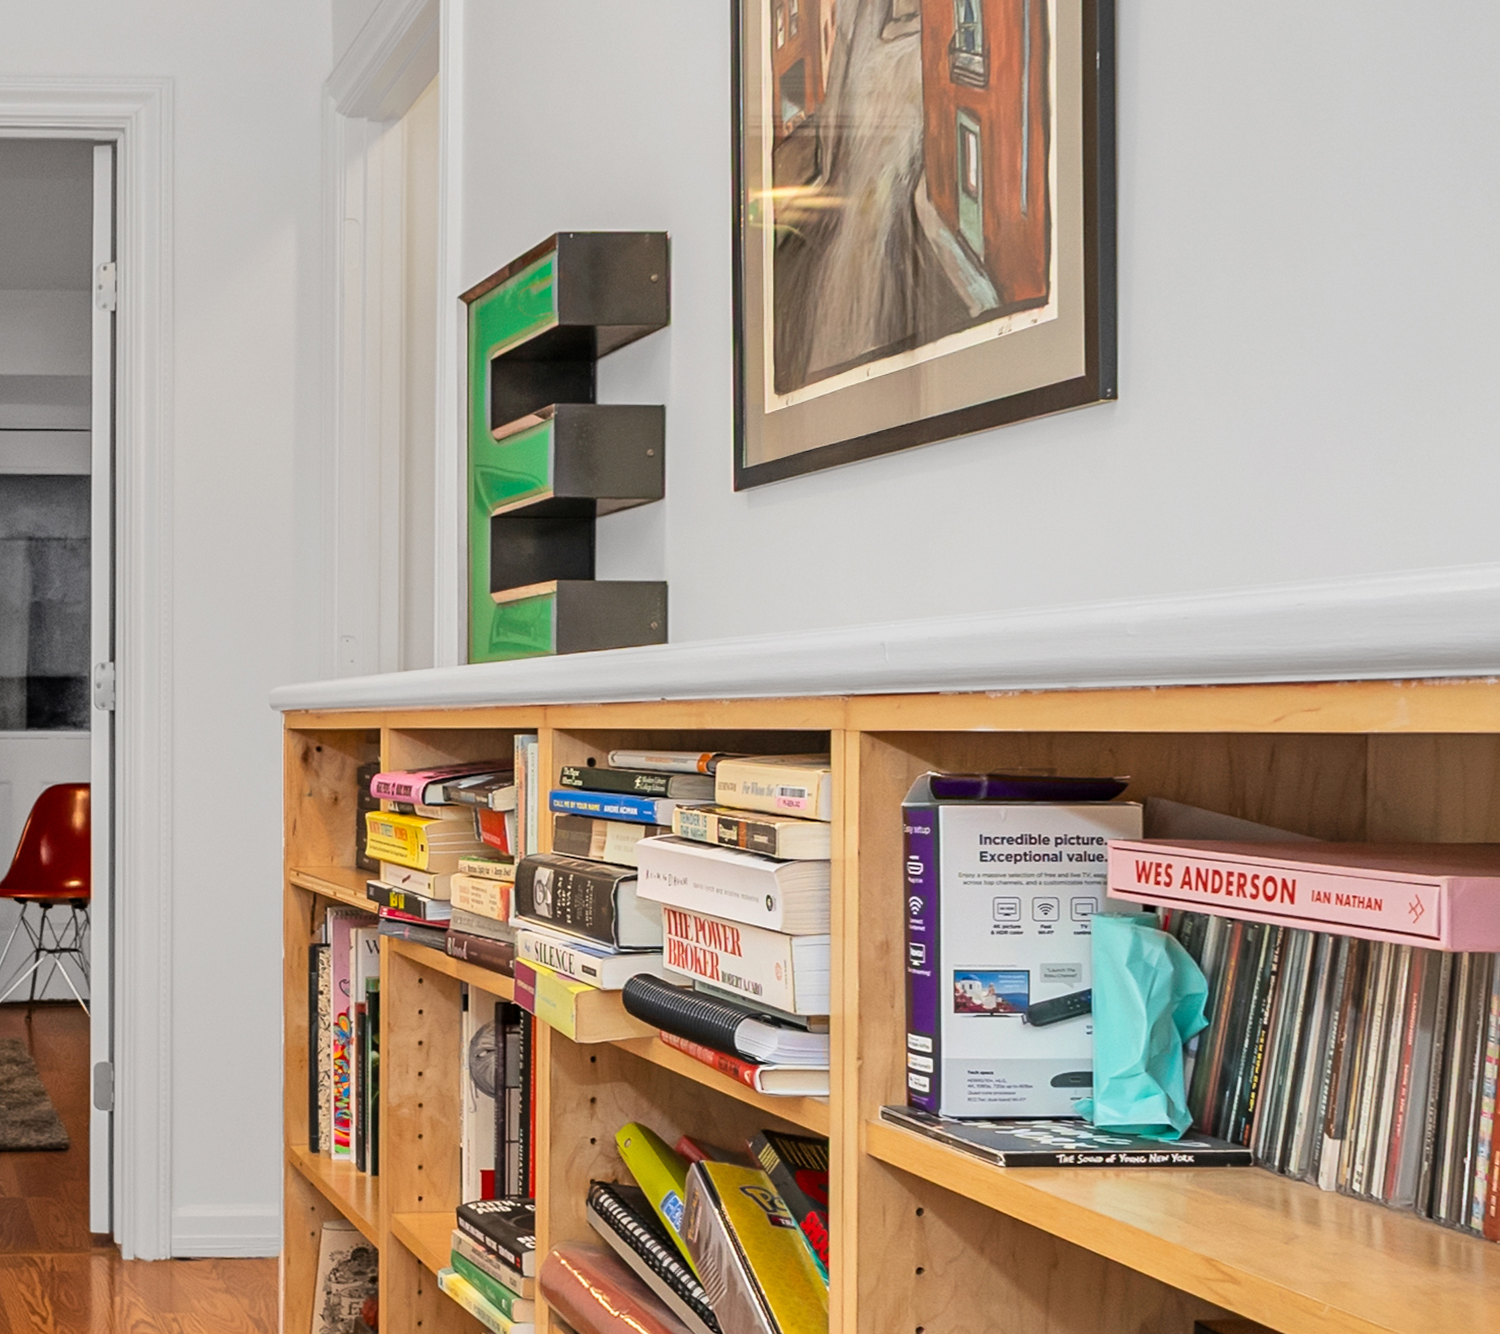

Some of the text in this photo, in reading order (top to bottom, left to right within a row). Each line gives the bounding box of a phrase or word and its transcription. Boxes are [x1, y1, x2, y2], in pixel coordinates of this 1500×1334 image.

[553, 799, 564, 807] CALL
[979, 834, 1108, 847] Incredible picture.
[979, 851, 1108, 864] Exceptional value.
[1135, 859, 1383, 912] WES ANDERSON IAN NATHAN
[664, 907, 743, 958] THE POWER
[534, 940, 576, 975] SILENCE
[667, 937, 721, 982] BROKER
